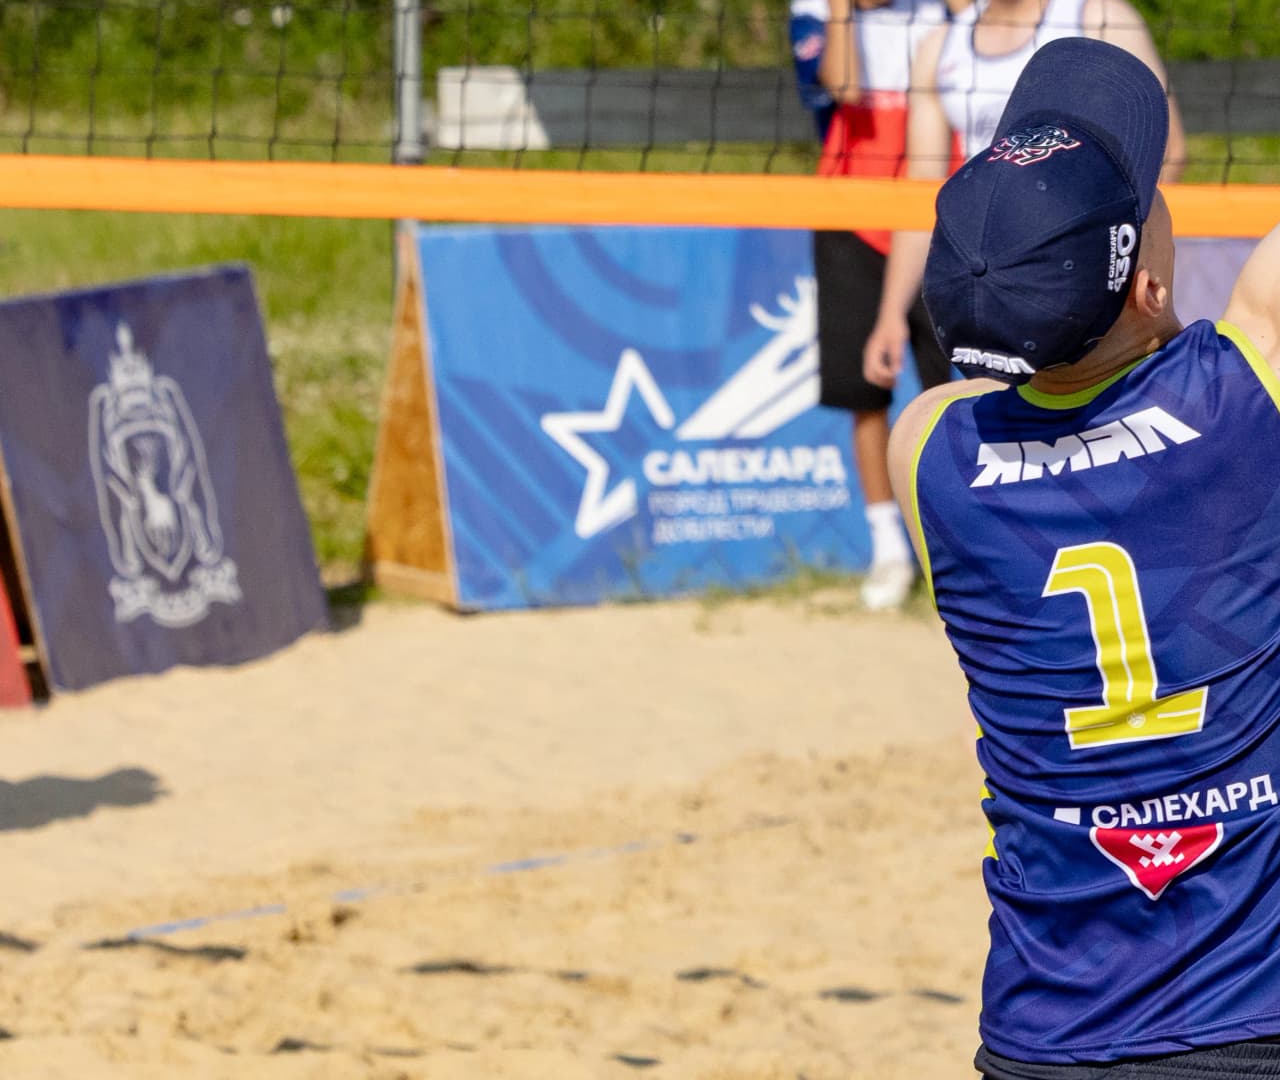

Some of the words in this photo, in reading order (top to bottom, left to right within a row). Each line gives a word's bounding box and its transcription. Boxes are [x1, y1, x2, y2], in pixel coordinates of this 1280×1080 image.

[643, 445, 848, 487] САЛЕХАРД
[1041, 541, 1209, 750] 1
[1091, 774, 1278, 829] САЛЕХАРД
